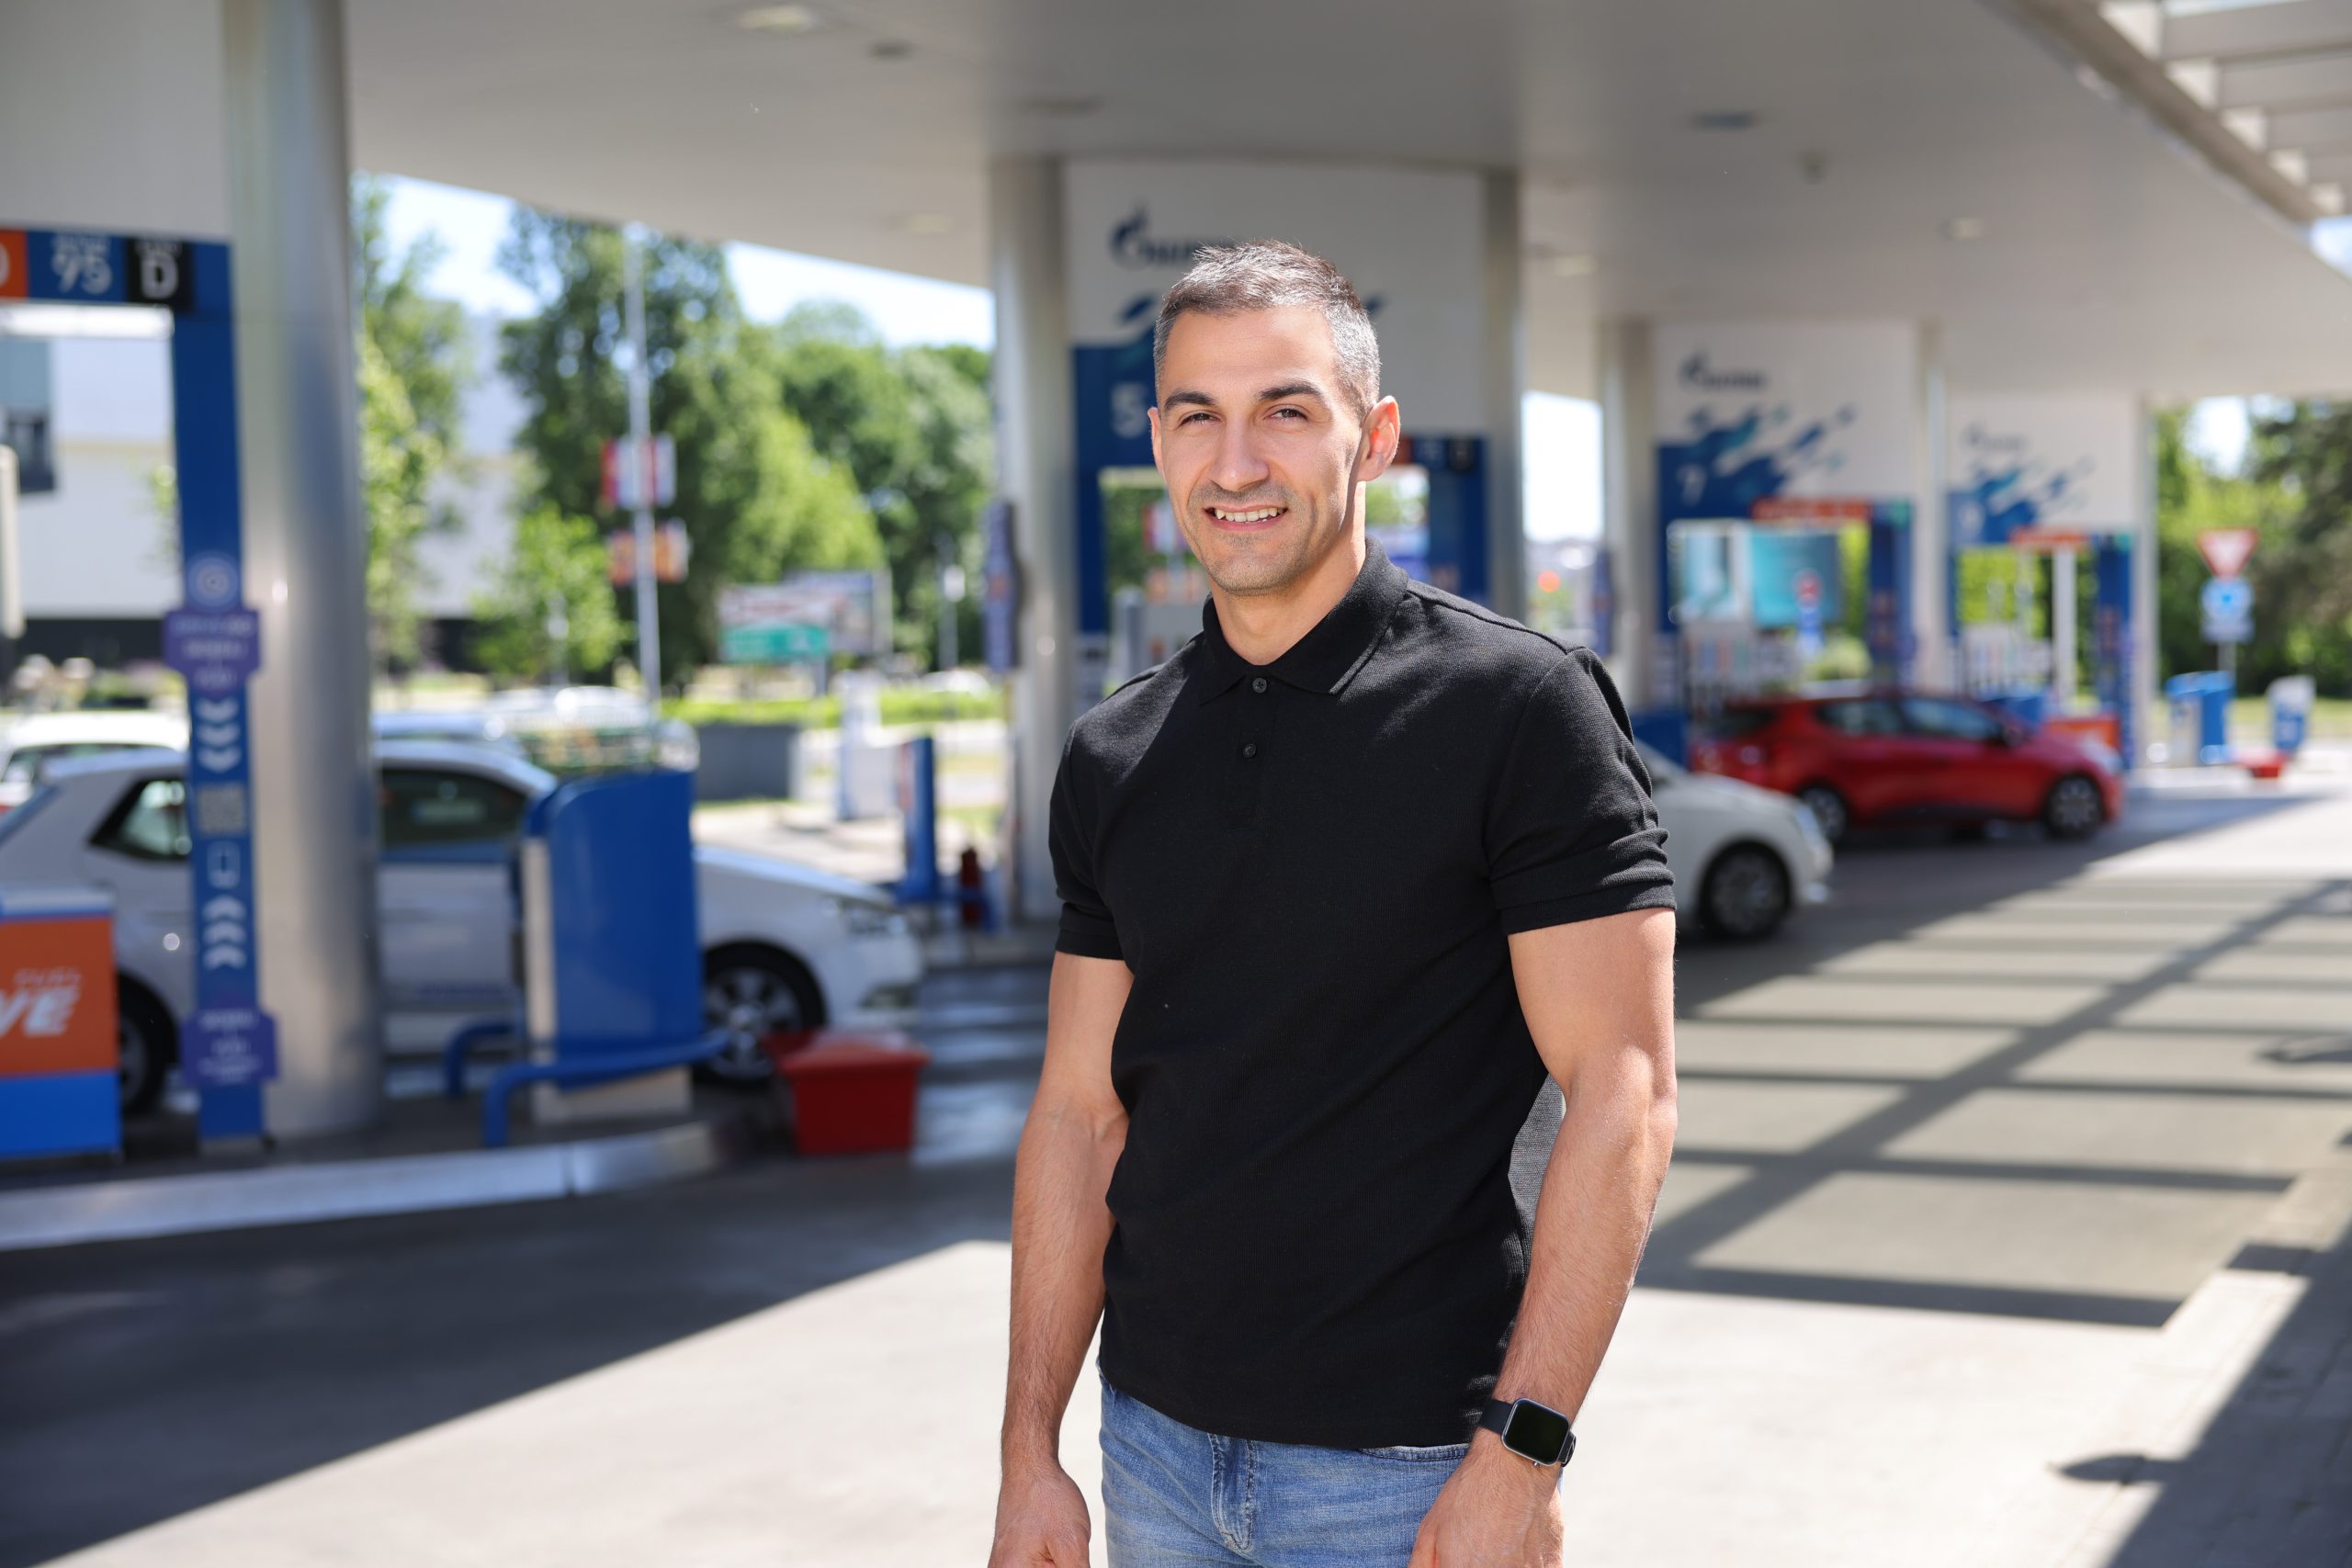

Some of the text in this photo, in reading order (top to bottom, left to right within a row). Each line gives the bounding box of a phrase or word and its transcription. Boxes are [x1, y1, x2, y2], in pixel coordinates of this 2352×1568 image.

[51, 242, 112, 295] 95
[140, 249, 178, 299] D
[1111, 382, 1148, 438] 5
